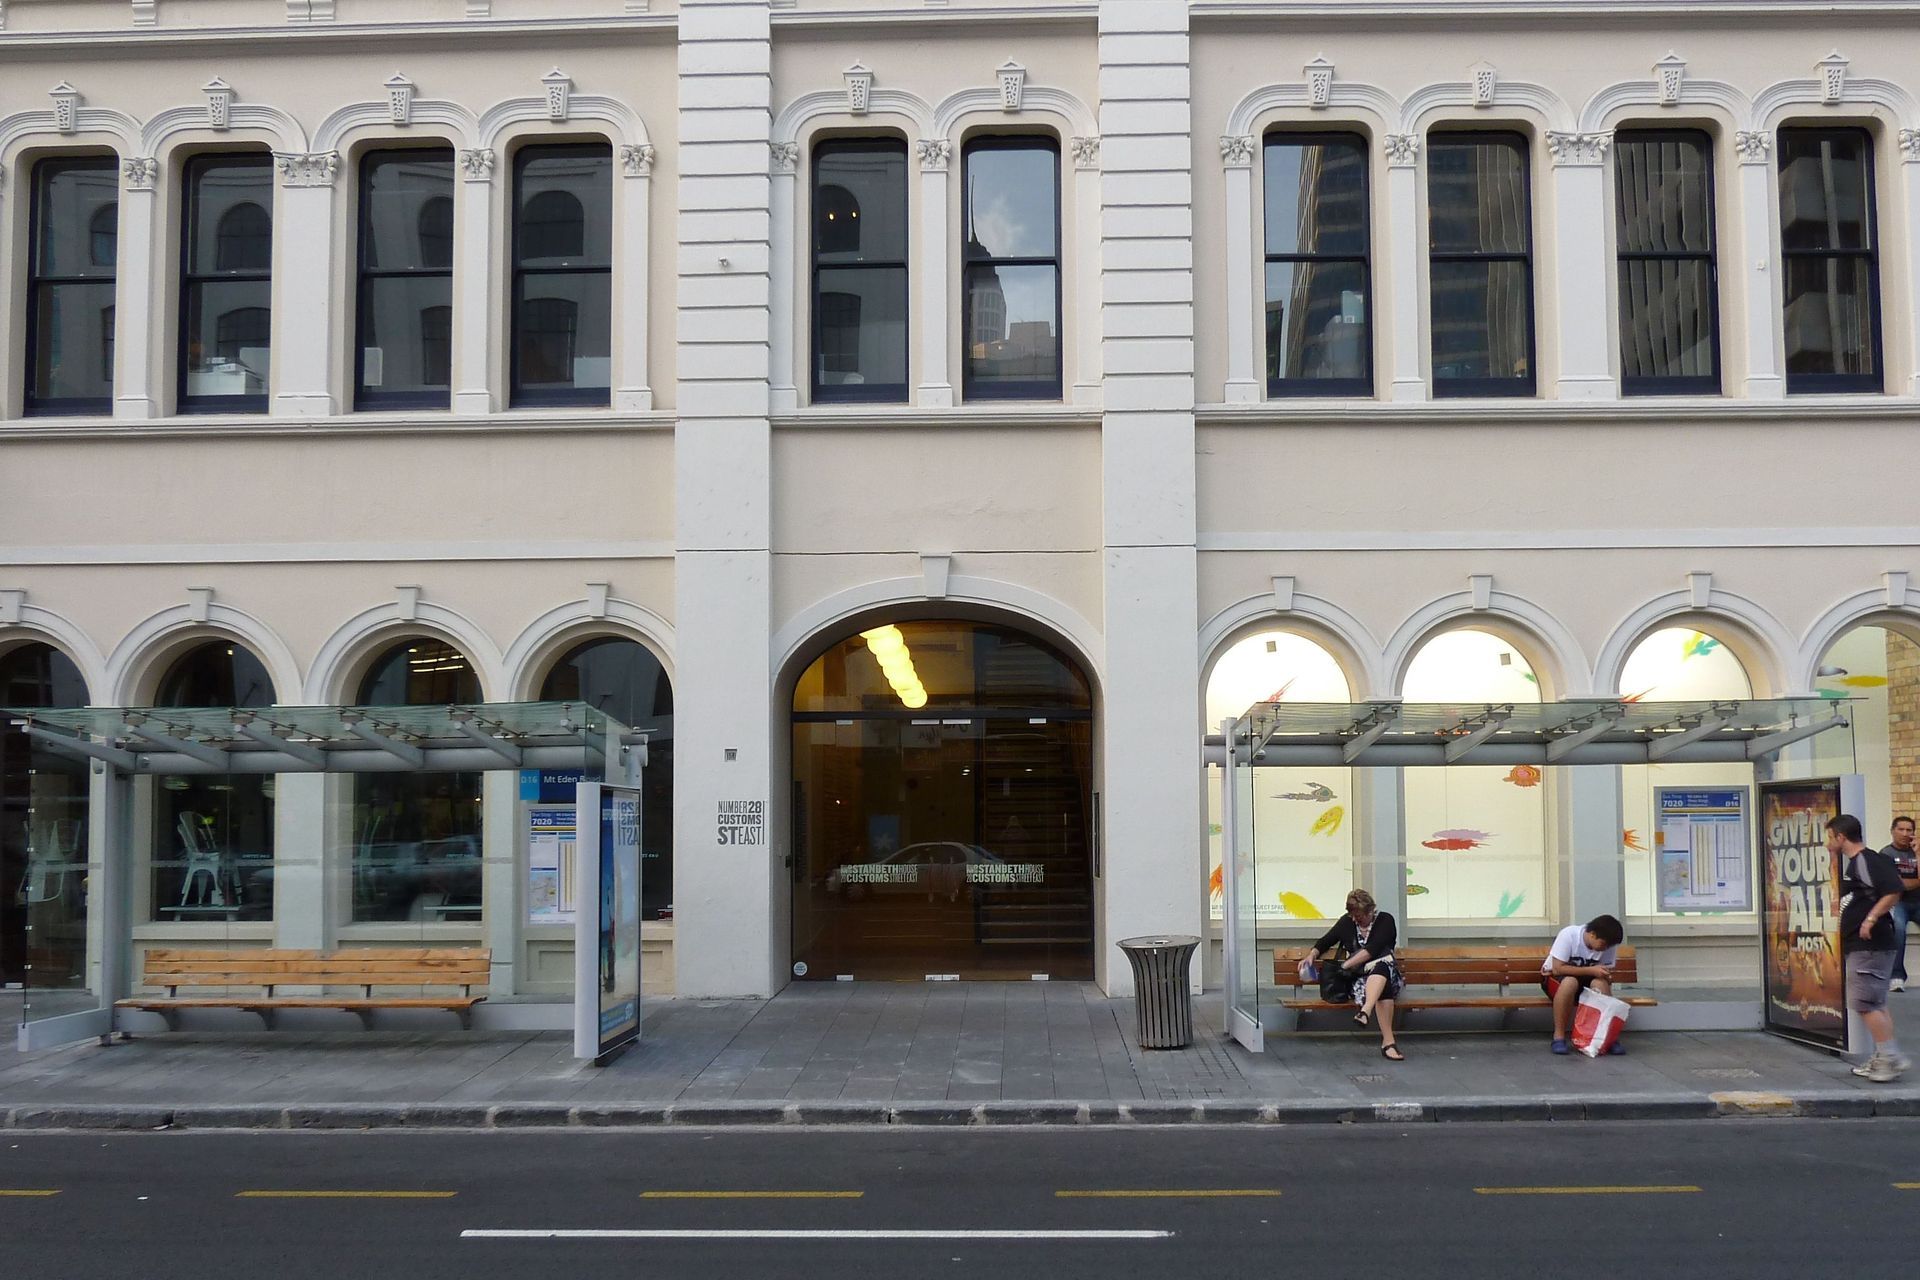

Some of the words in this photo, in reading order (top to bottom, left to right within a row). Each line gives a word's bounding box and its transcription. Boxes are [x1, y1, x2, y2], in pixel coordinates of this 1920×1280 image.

[544, 775, 556, 783] Mt
[557, 775, 578, 783] Eden
[717, 814, 762, 825] CUSTOMS
[1770, 812, 1809, 846] GIVE
[717, 826, 738, 845] ST
[738, 826, 761, 845] EAST
[853, 864, 898, 874] STANBETH
[979, 864, 1024, 874] STANBETH
[1771, 847, 1831, 883] YOUR
[847, 873, 890, 883] CUSTOMS
[973, 873, 1015, 883] CUSTOMS
[1788, 885, 1838, 932] ALL
